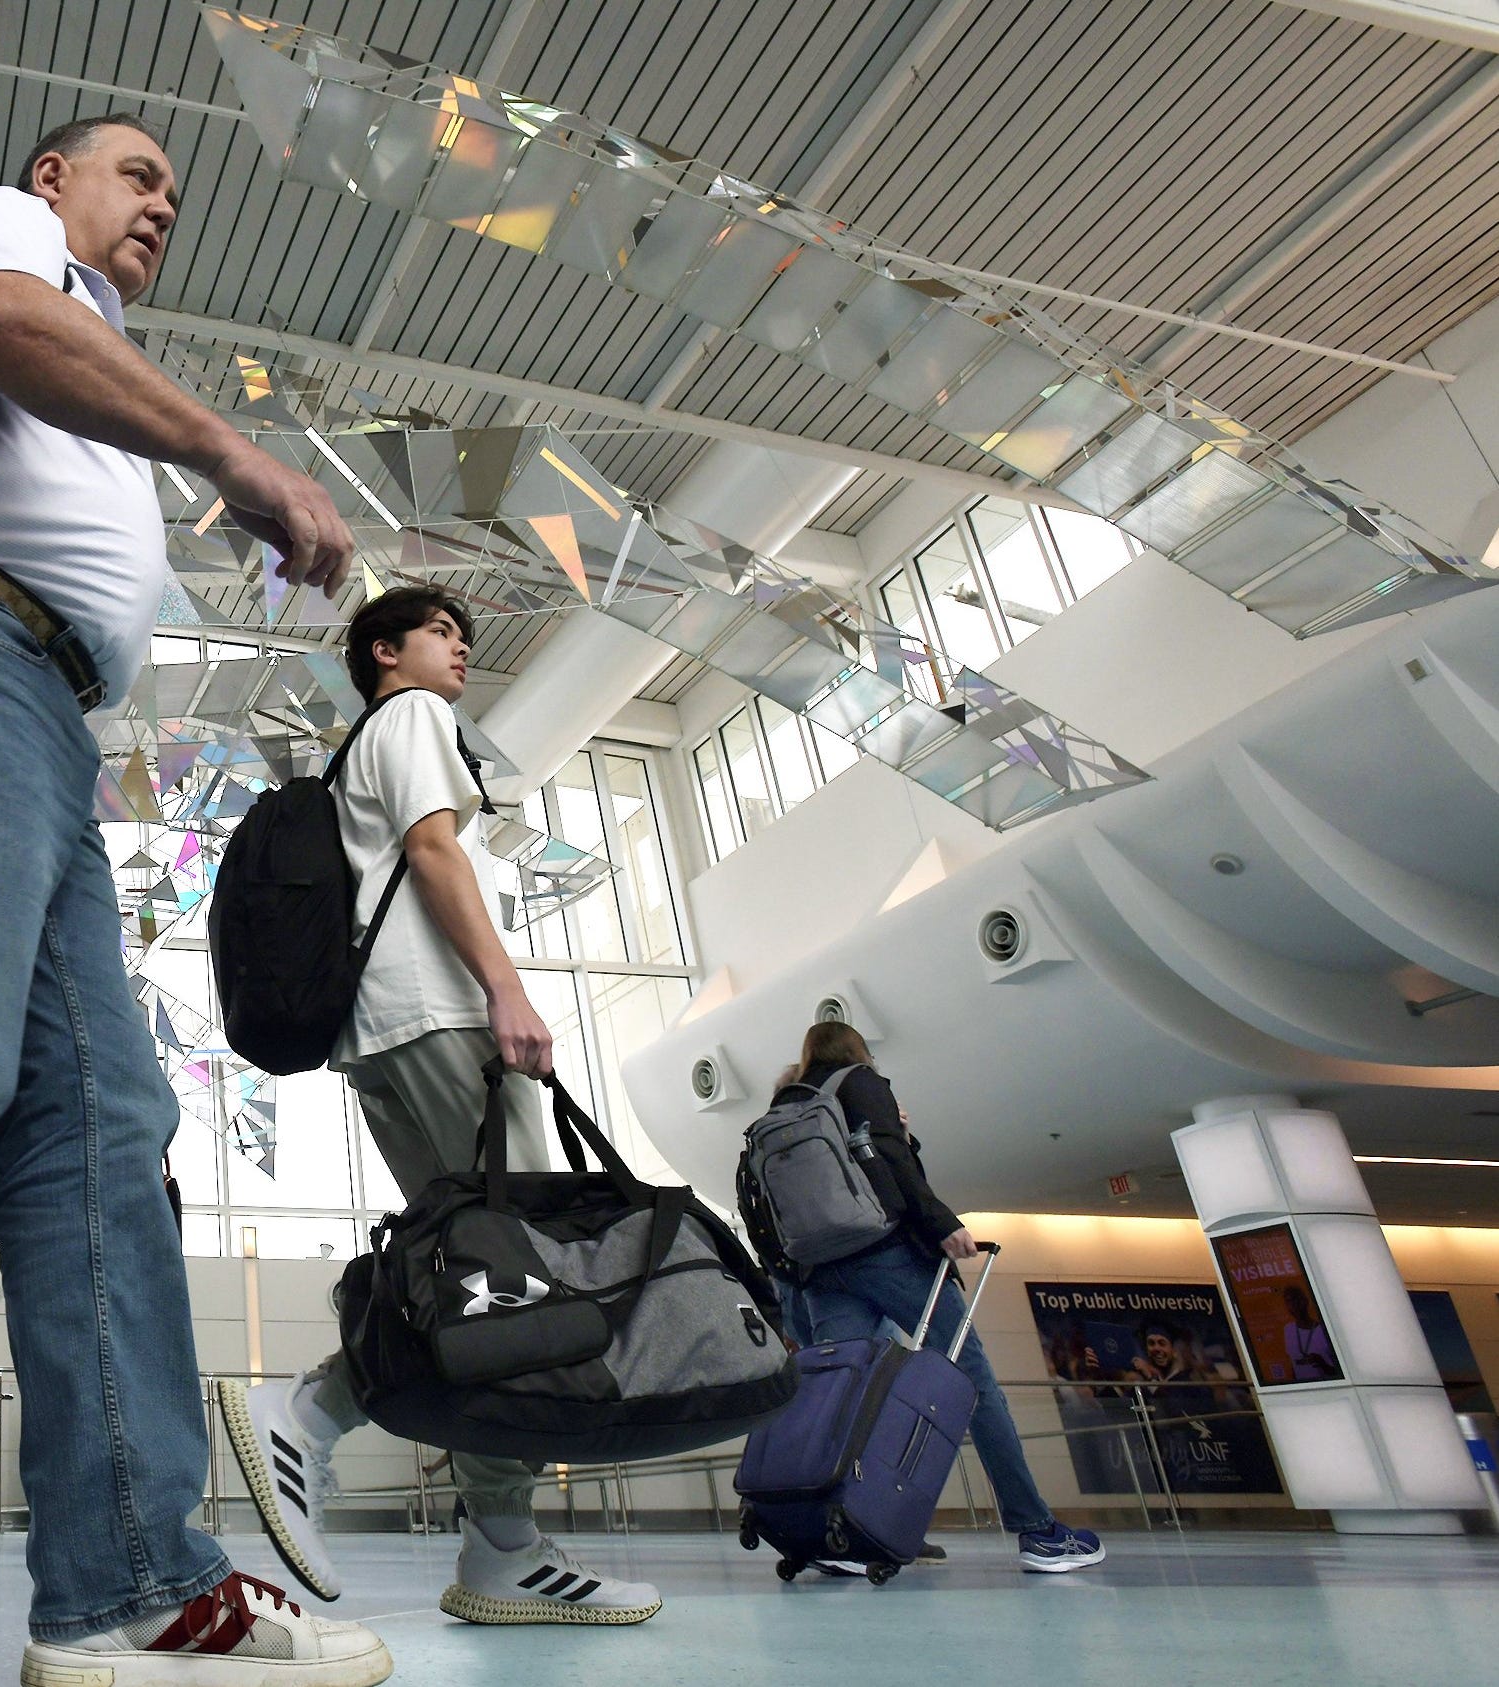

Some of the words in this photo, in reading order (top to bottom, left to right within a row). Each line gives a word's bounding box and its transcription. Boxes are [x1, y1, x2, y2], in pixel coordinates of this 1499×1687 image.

[1231, 1260, 1296, 1282] VISIBLE
[1035, 1292, 1070, 1313] Top
[1072, 1292, 1126, 1310] Public
[1128, 1294, 1214, 1316] University
[1189, 1441, 1230, 1462] UNF
